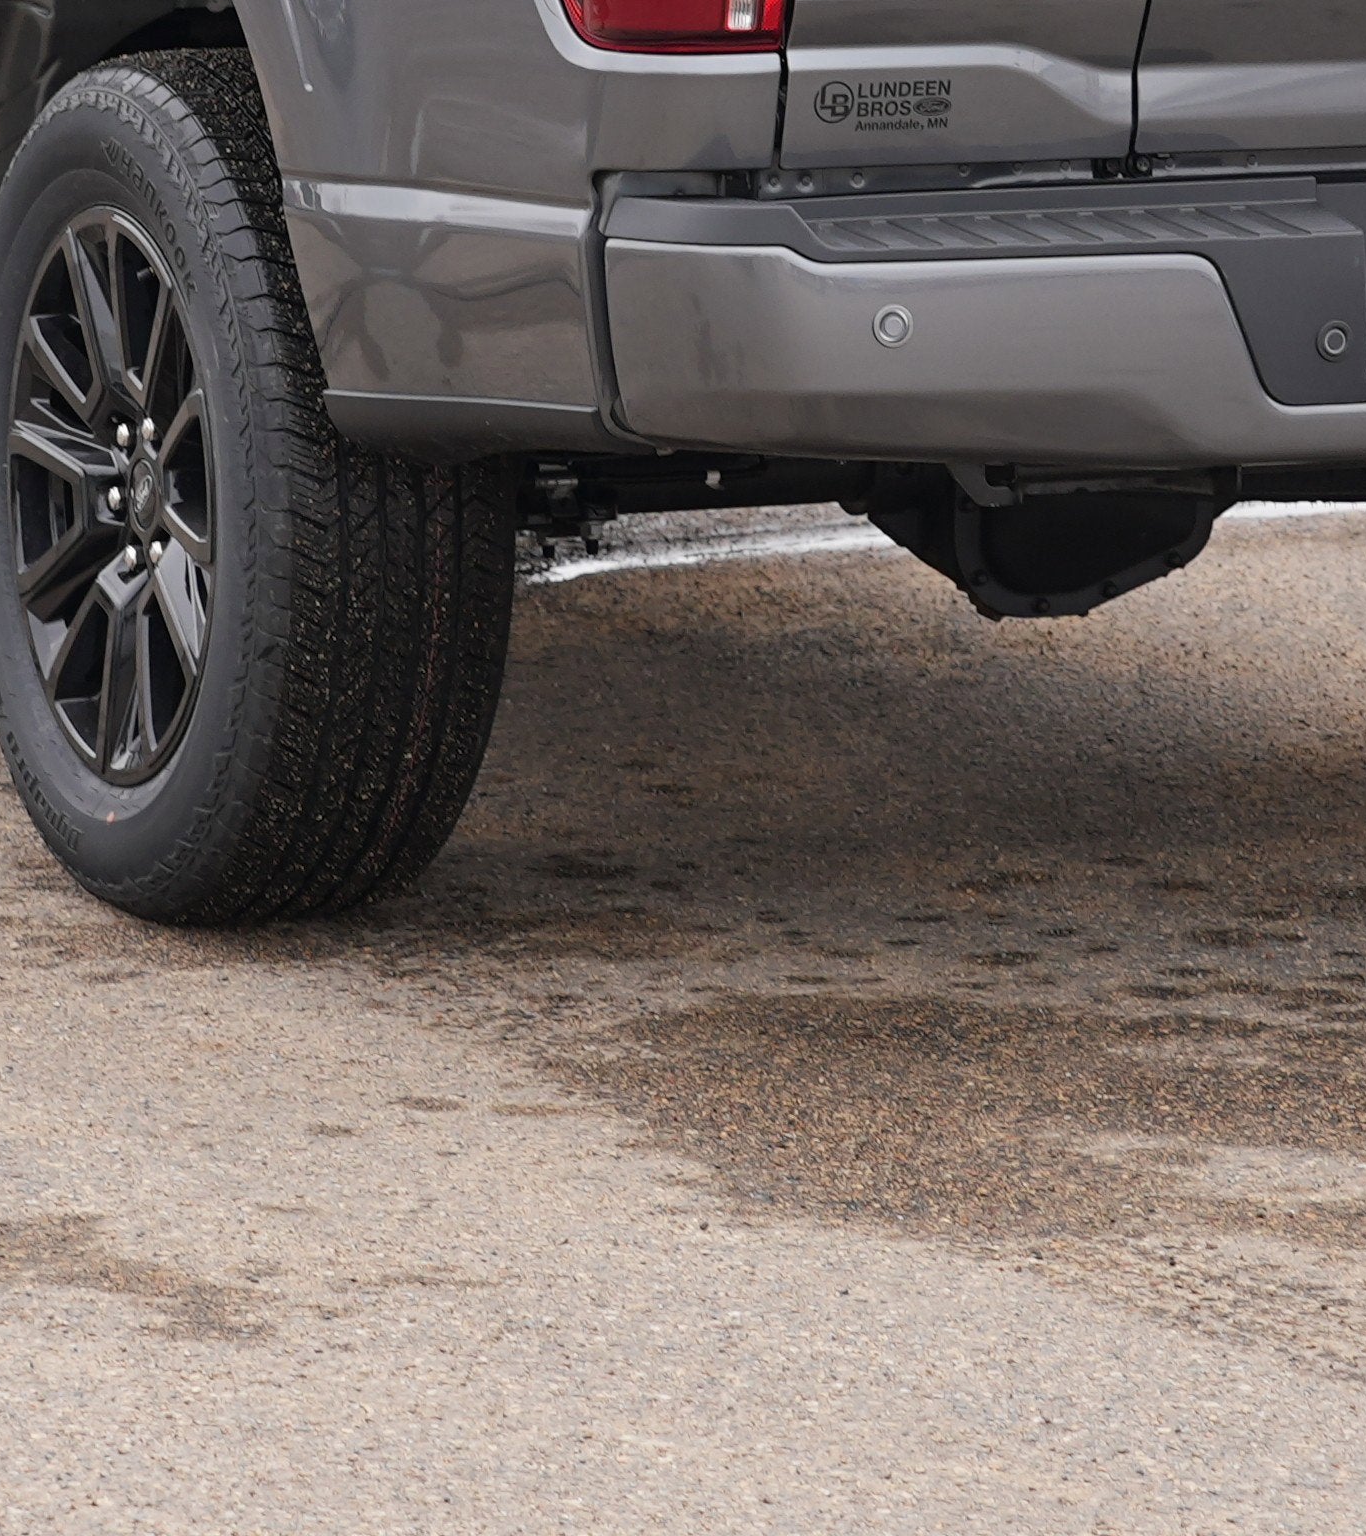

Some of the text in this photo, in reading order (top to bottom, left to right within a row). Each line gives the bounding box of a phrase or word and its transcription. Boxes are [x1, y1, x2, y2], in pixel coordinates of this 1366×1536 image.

[858, 79, 951, 99] LUNDEEN
[857, 100, 911, 117] BROS
[855, 117, 948, 131] Annandale, MN
